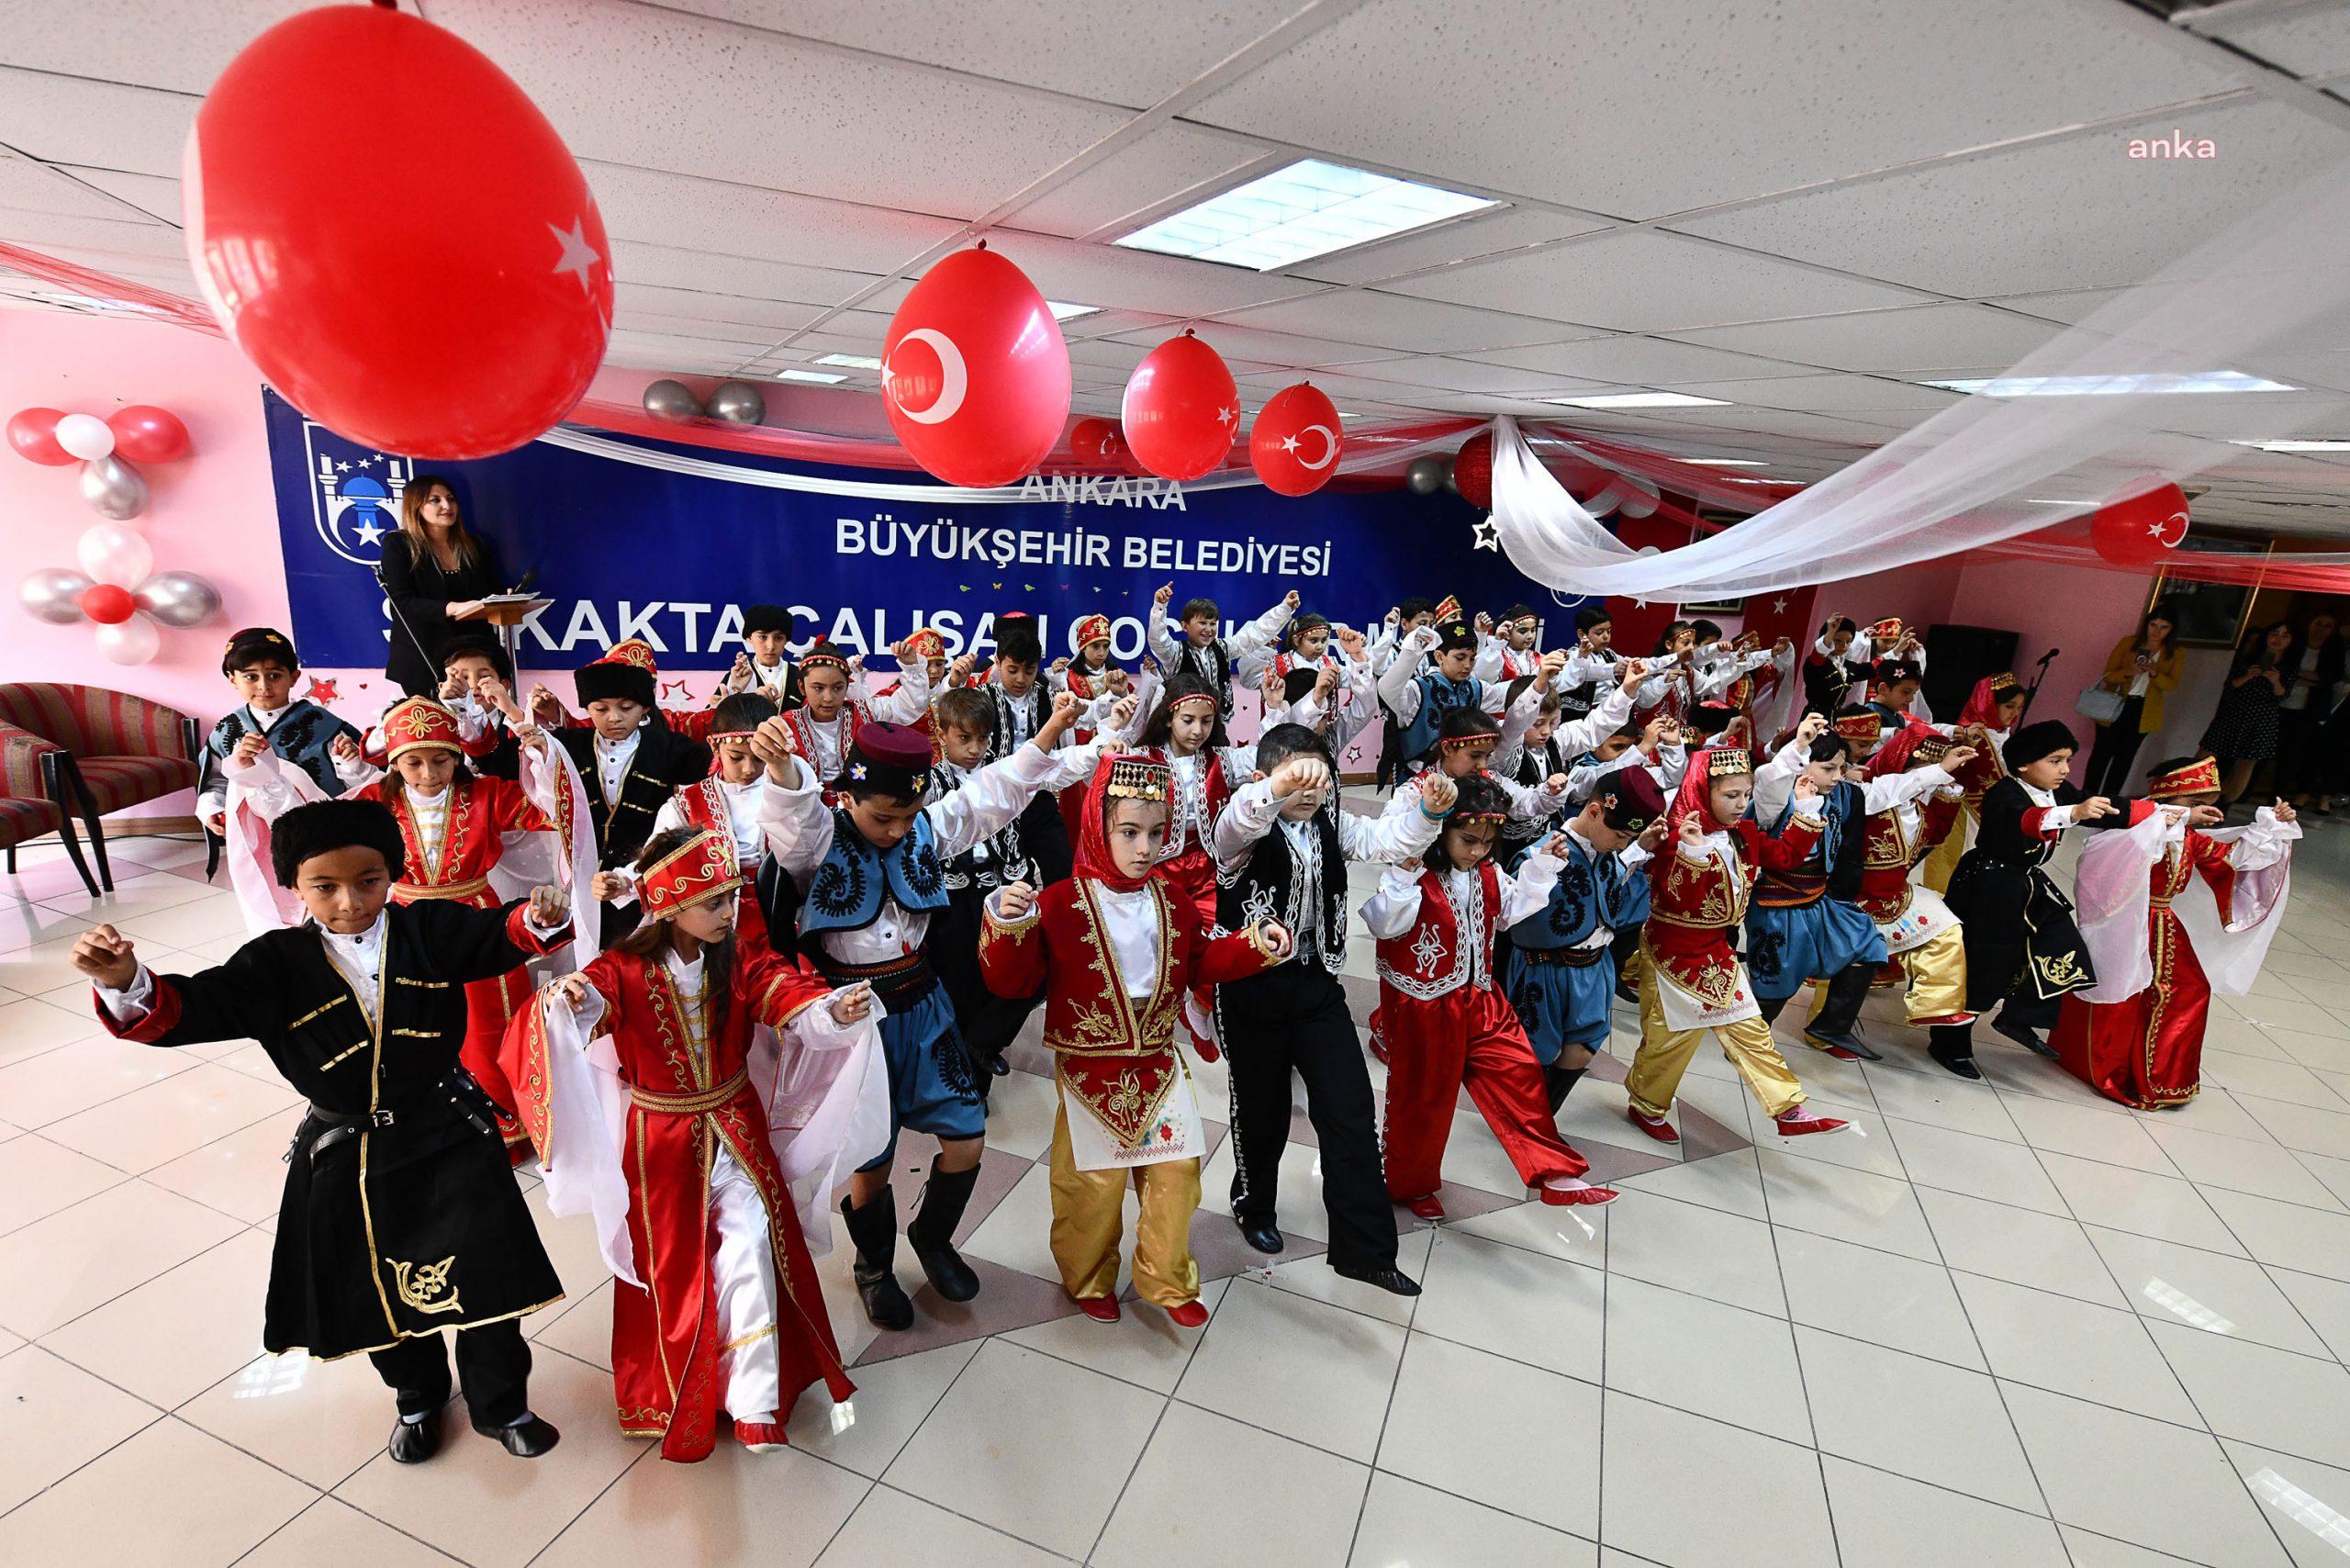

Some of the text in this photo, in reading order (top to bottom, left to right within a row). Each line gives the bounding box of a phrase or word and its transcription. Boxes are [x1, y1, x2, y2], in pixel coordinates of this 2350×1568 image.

[1019, 469, 1187, 511] ANKARA
[836, 513, 1332, 577] BÜYÜKŞEHİR BELEDİYESİ
[381, 597, 756, 654] KAKTA
